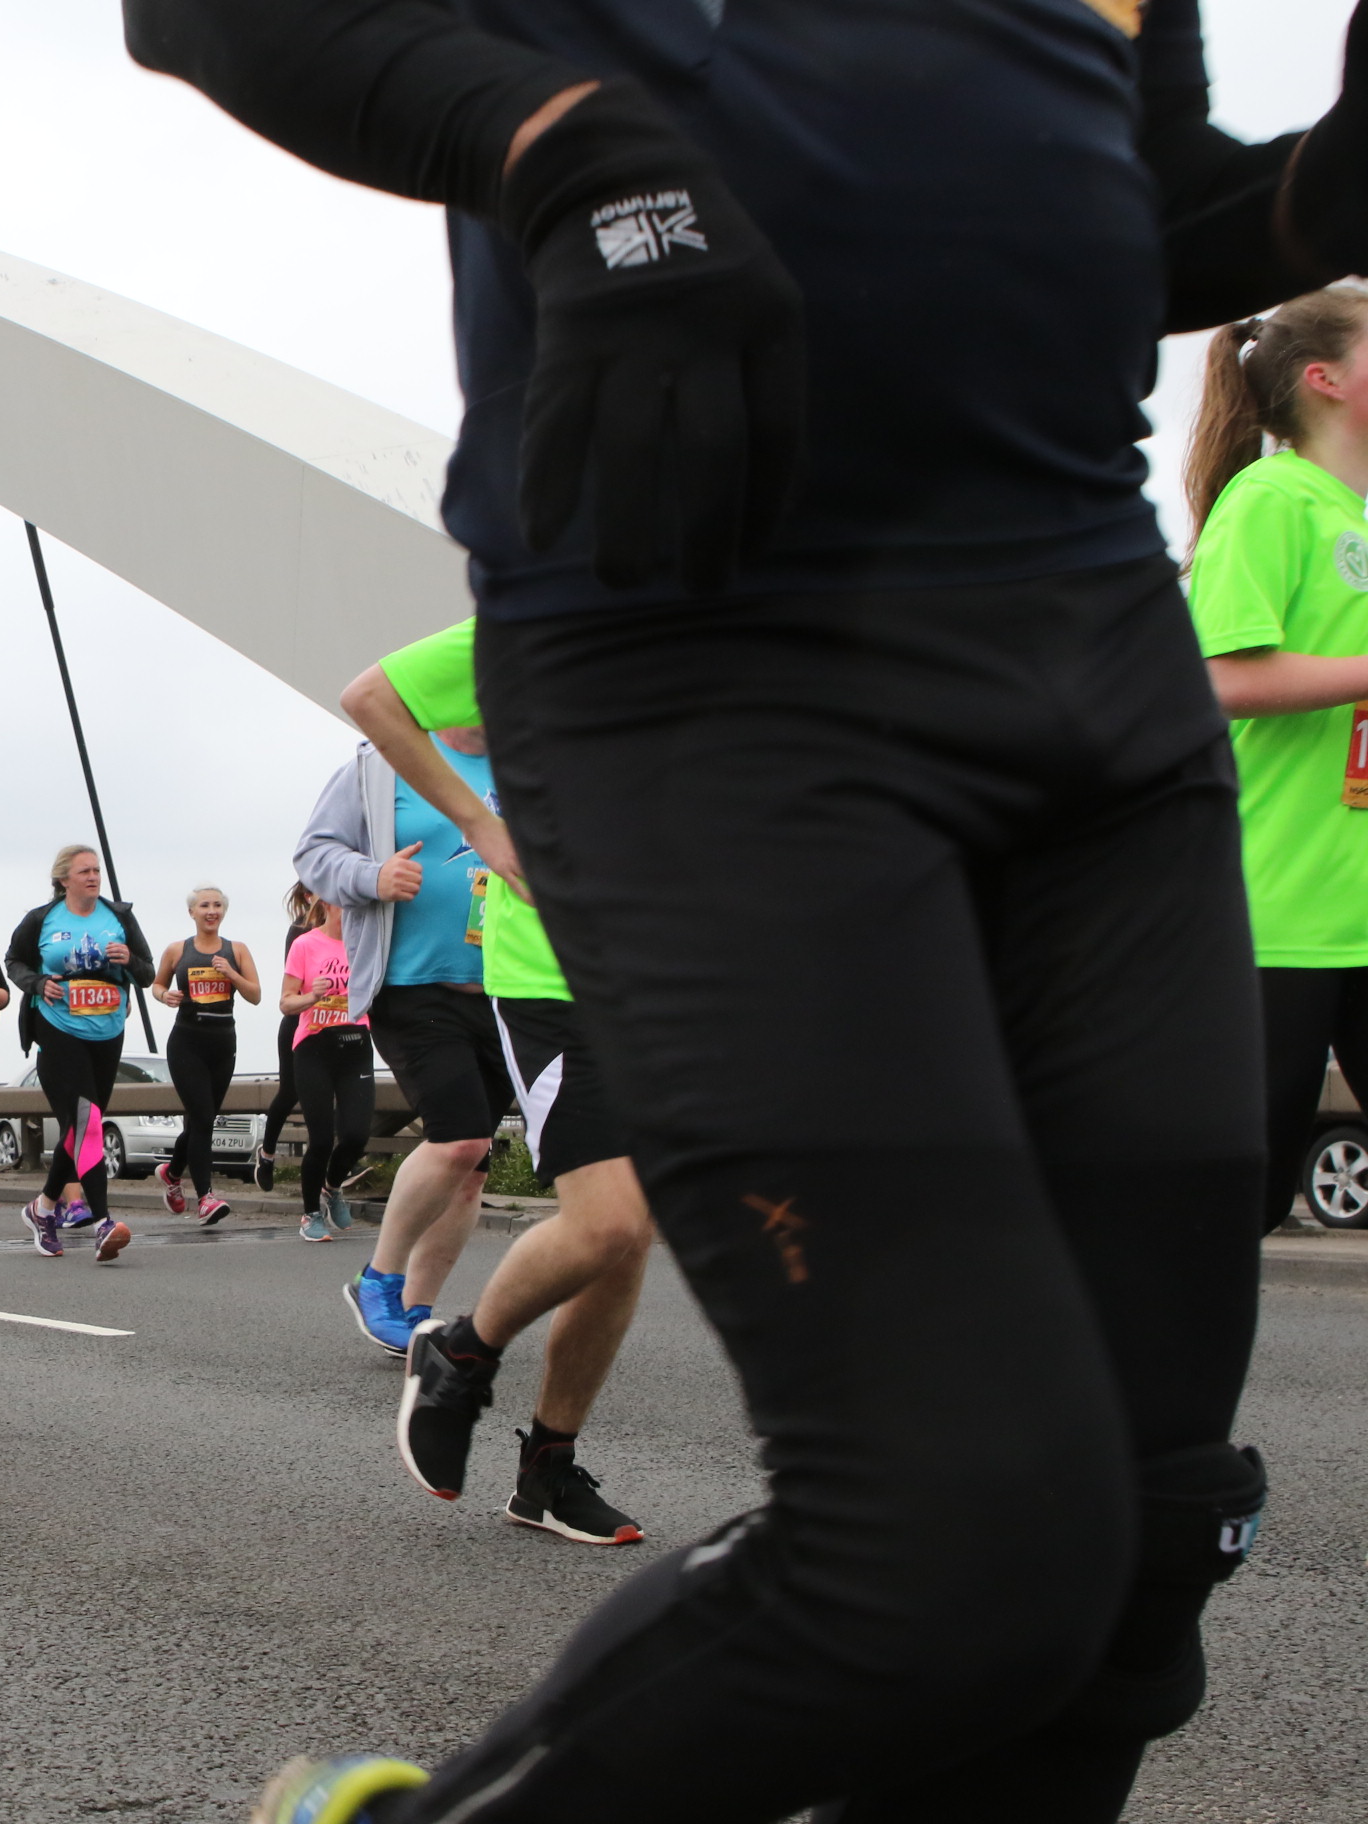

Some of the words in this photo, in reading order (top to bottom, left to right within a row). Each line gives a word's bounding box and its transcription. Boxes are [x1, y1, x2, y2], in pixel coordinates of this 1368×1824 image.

[190, 981, 225, 996] 10828
[71, 988, 112, 1005] 11361
[228, 1138, 244, 1148] ZPU
